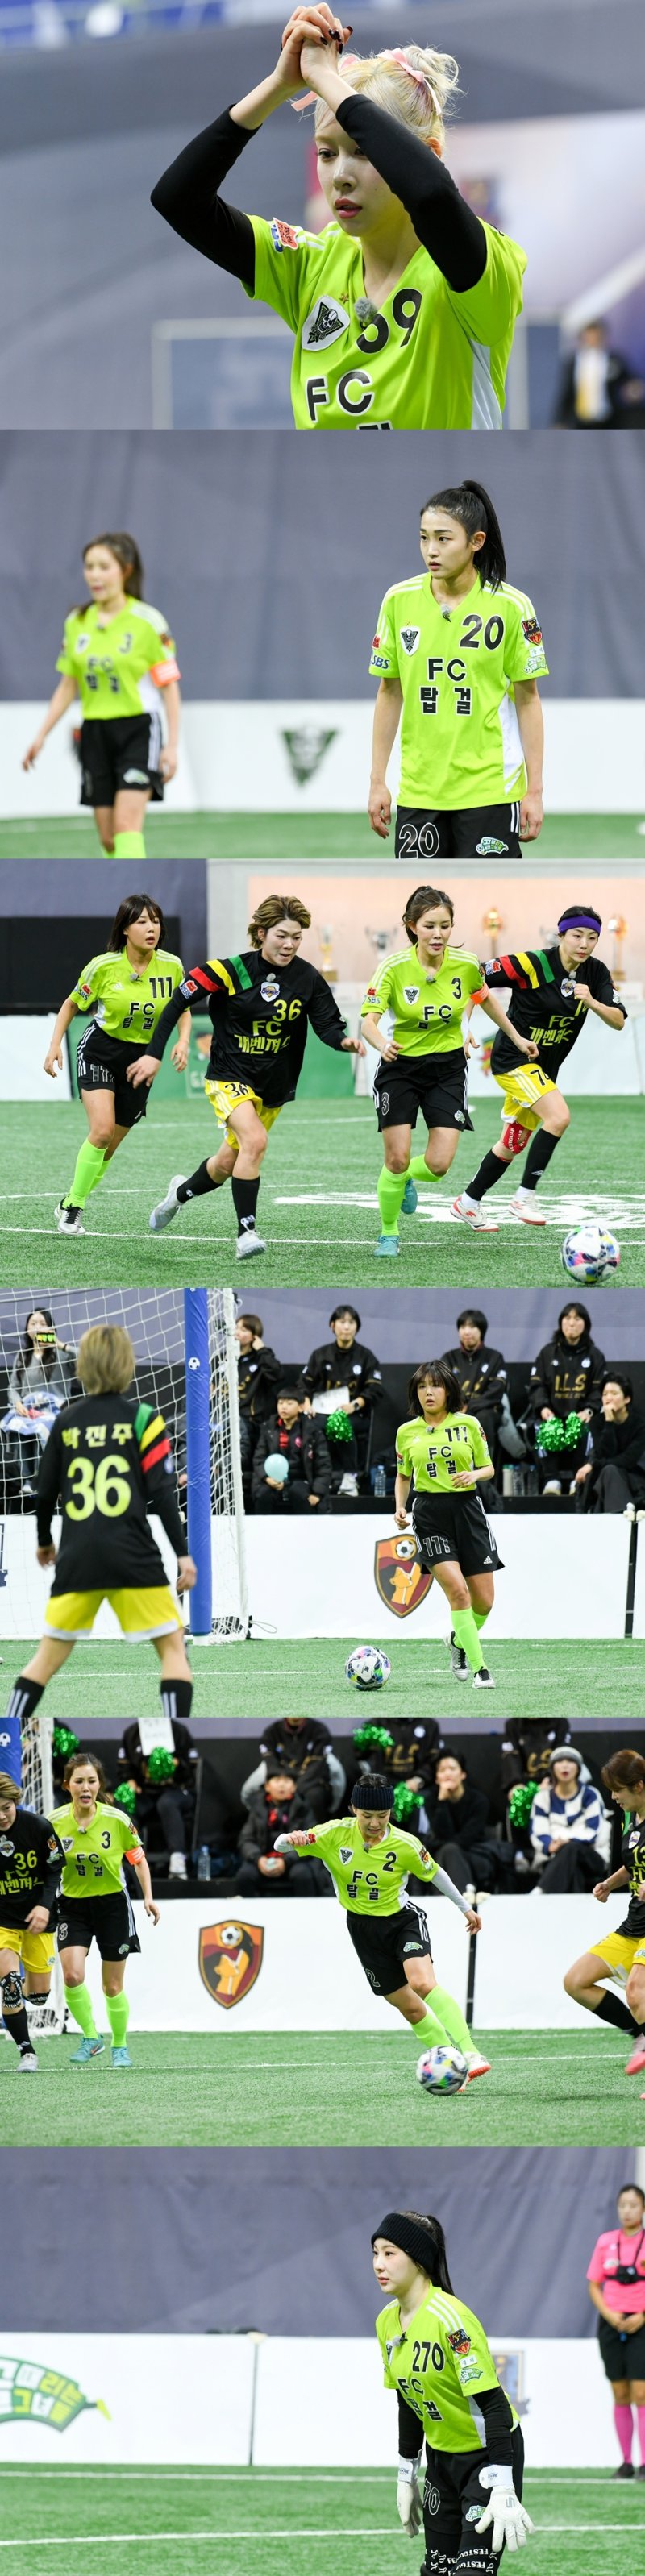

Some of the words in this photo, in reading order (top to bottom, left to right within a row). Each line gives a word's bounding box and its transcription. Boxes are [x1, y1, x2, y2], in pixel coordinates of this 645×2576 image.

[306, 369, 374, 422] FC
[460, 614, 504, 650] 20
[372, 655, 390, 669] SBS
[428, 658, 466, 681] FC
[398, 822, 440, 859] 20
[149, 976, 173, 999] 111
[451, 978, 462, 999] 3
[130, 1002, 155, 1016] FC
[272, 999, 302, 1022] 36
[423, 1004, 452, 1020] FC
[252, 1020, 282, 1037] FC
[548, 1015, 575, 1028] FC
[224, 1083, 249, 1098] 36
[381, 1092, 389, 1116] 3
[61, 1423, 134, 1449] 박진주
[444, 1427, 468, 1443] 111
[428, 1446, 452, 1460] FC
[65, 1455, 131, 1521] 36
[101, 1831, 111, 1850] 3
[14, 1851, 38, 1870] 36
[76, 1854, 100, 1864] FC
[382, 1851, 397, 1872] 2
[352, 1871, 378, 1885] FC
[59, 1923, 68, 1941] 3
[365, 1969, 380, 1988] 2
[412, 2341, 445, 2373] 270
[397, 2378, 424, 2395] FC
